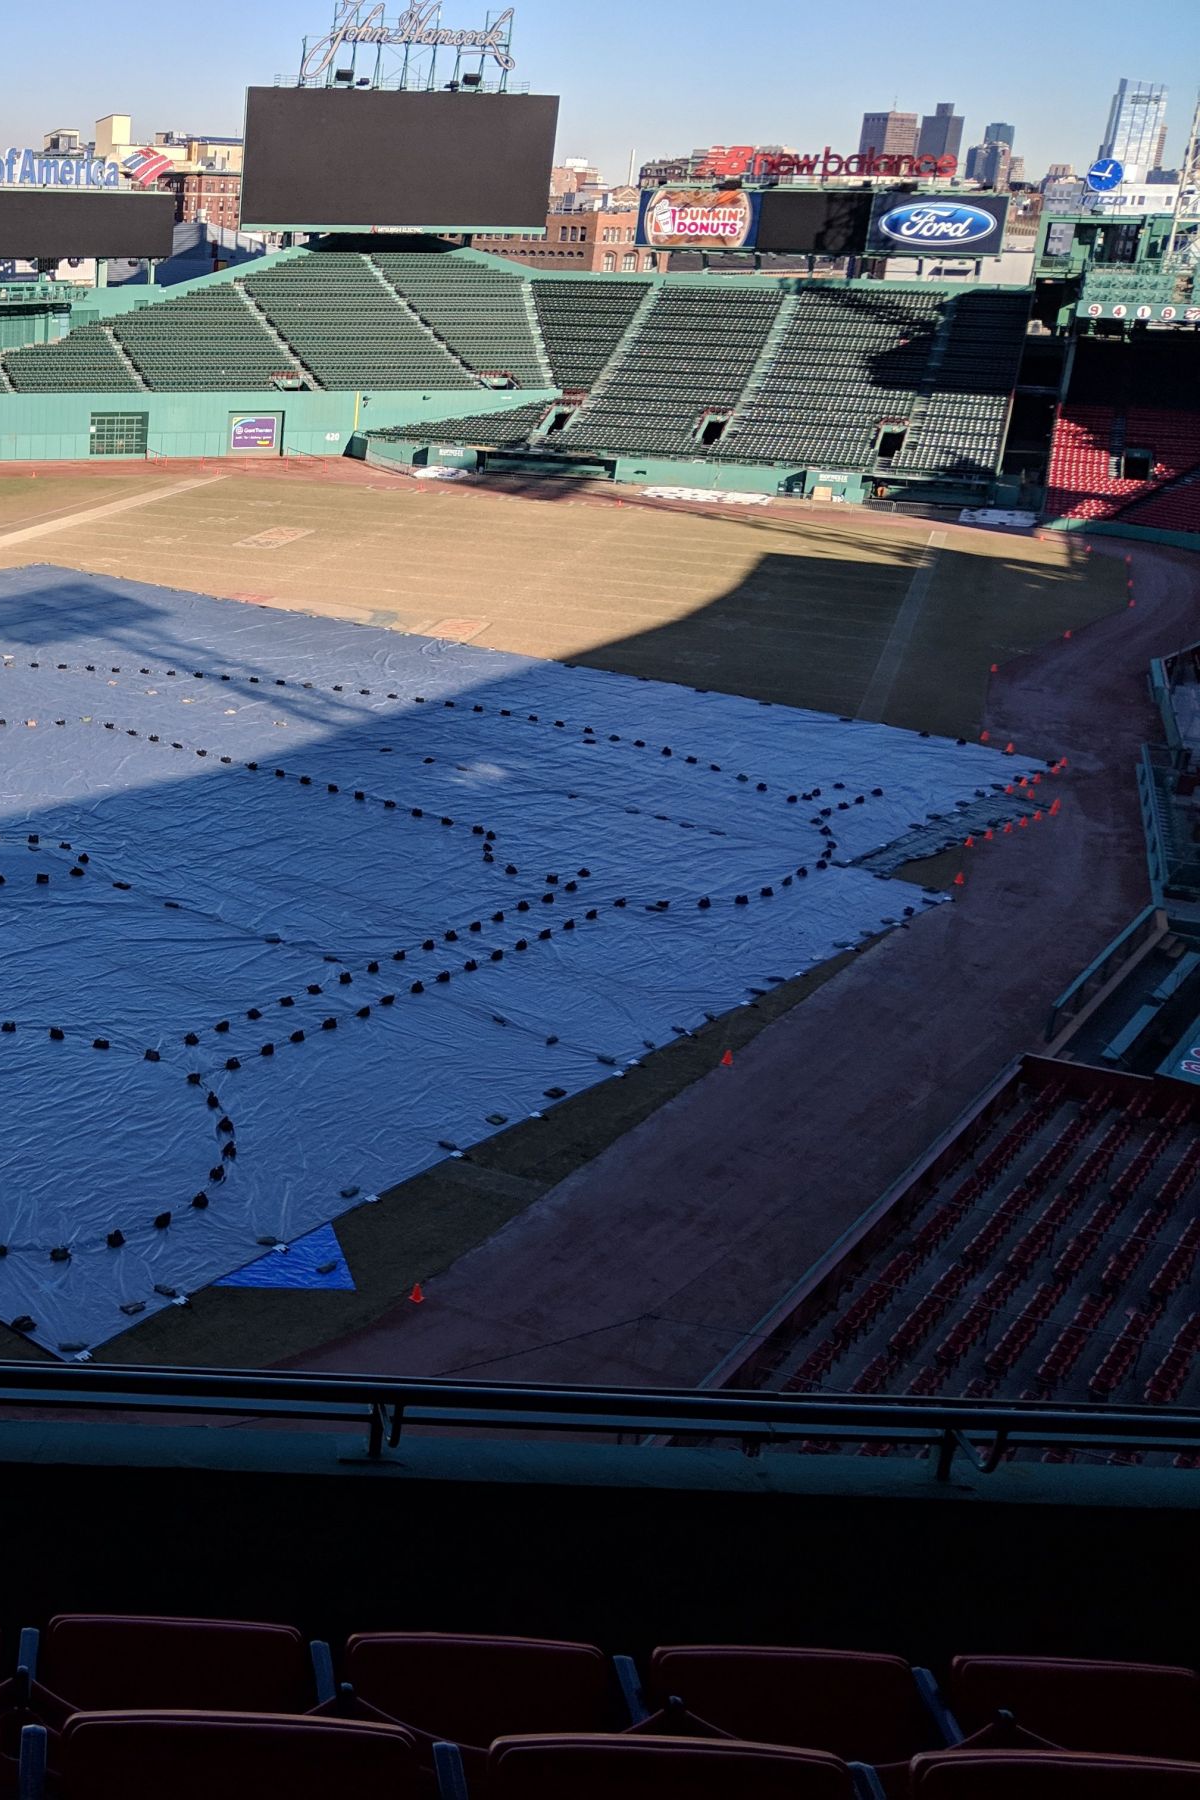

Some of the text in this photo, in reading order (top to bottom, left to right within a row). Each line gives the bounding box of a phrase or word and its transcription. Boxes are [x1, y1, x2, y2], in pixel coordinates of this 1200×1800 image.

[302, 0, 515, 78] John Hancock
[18, 148, 120, 186] America
[753, 146, 958, 177] new balance
[676, 221, 738, 235] DONUTS
[900, 208, 974, 237] Ford
[325, 432, 340, 441] 420
